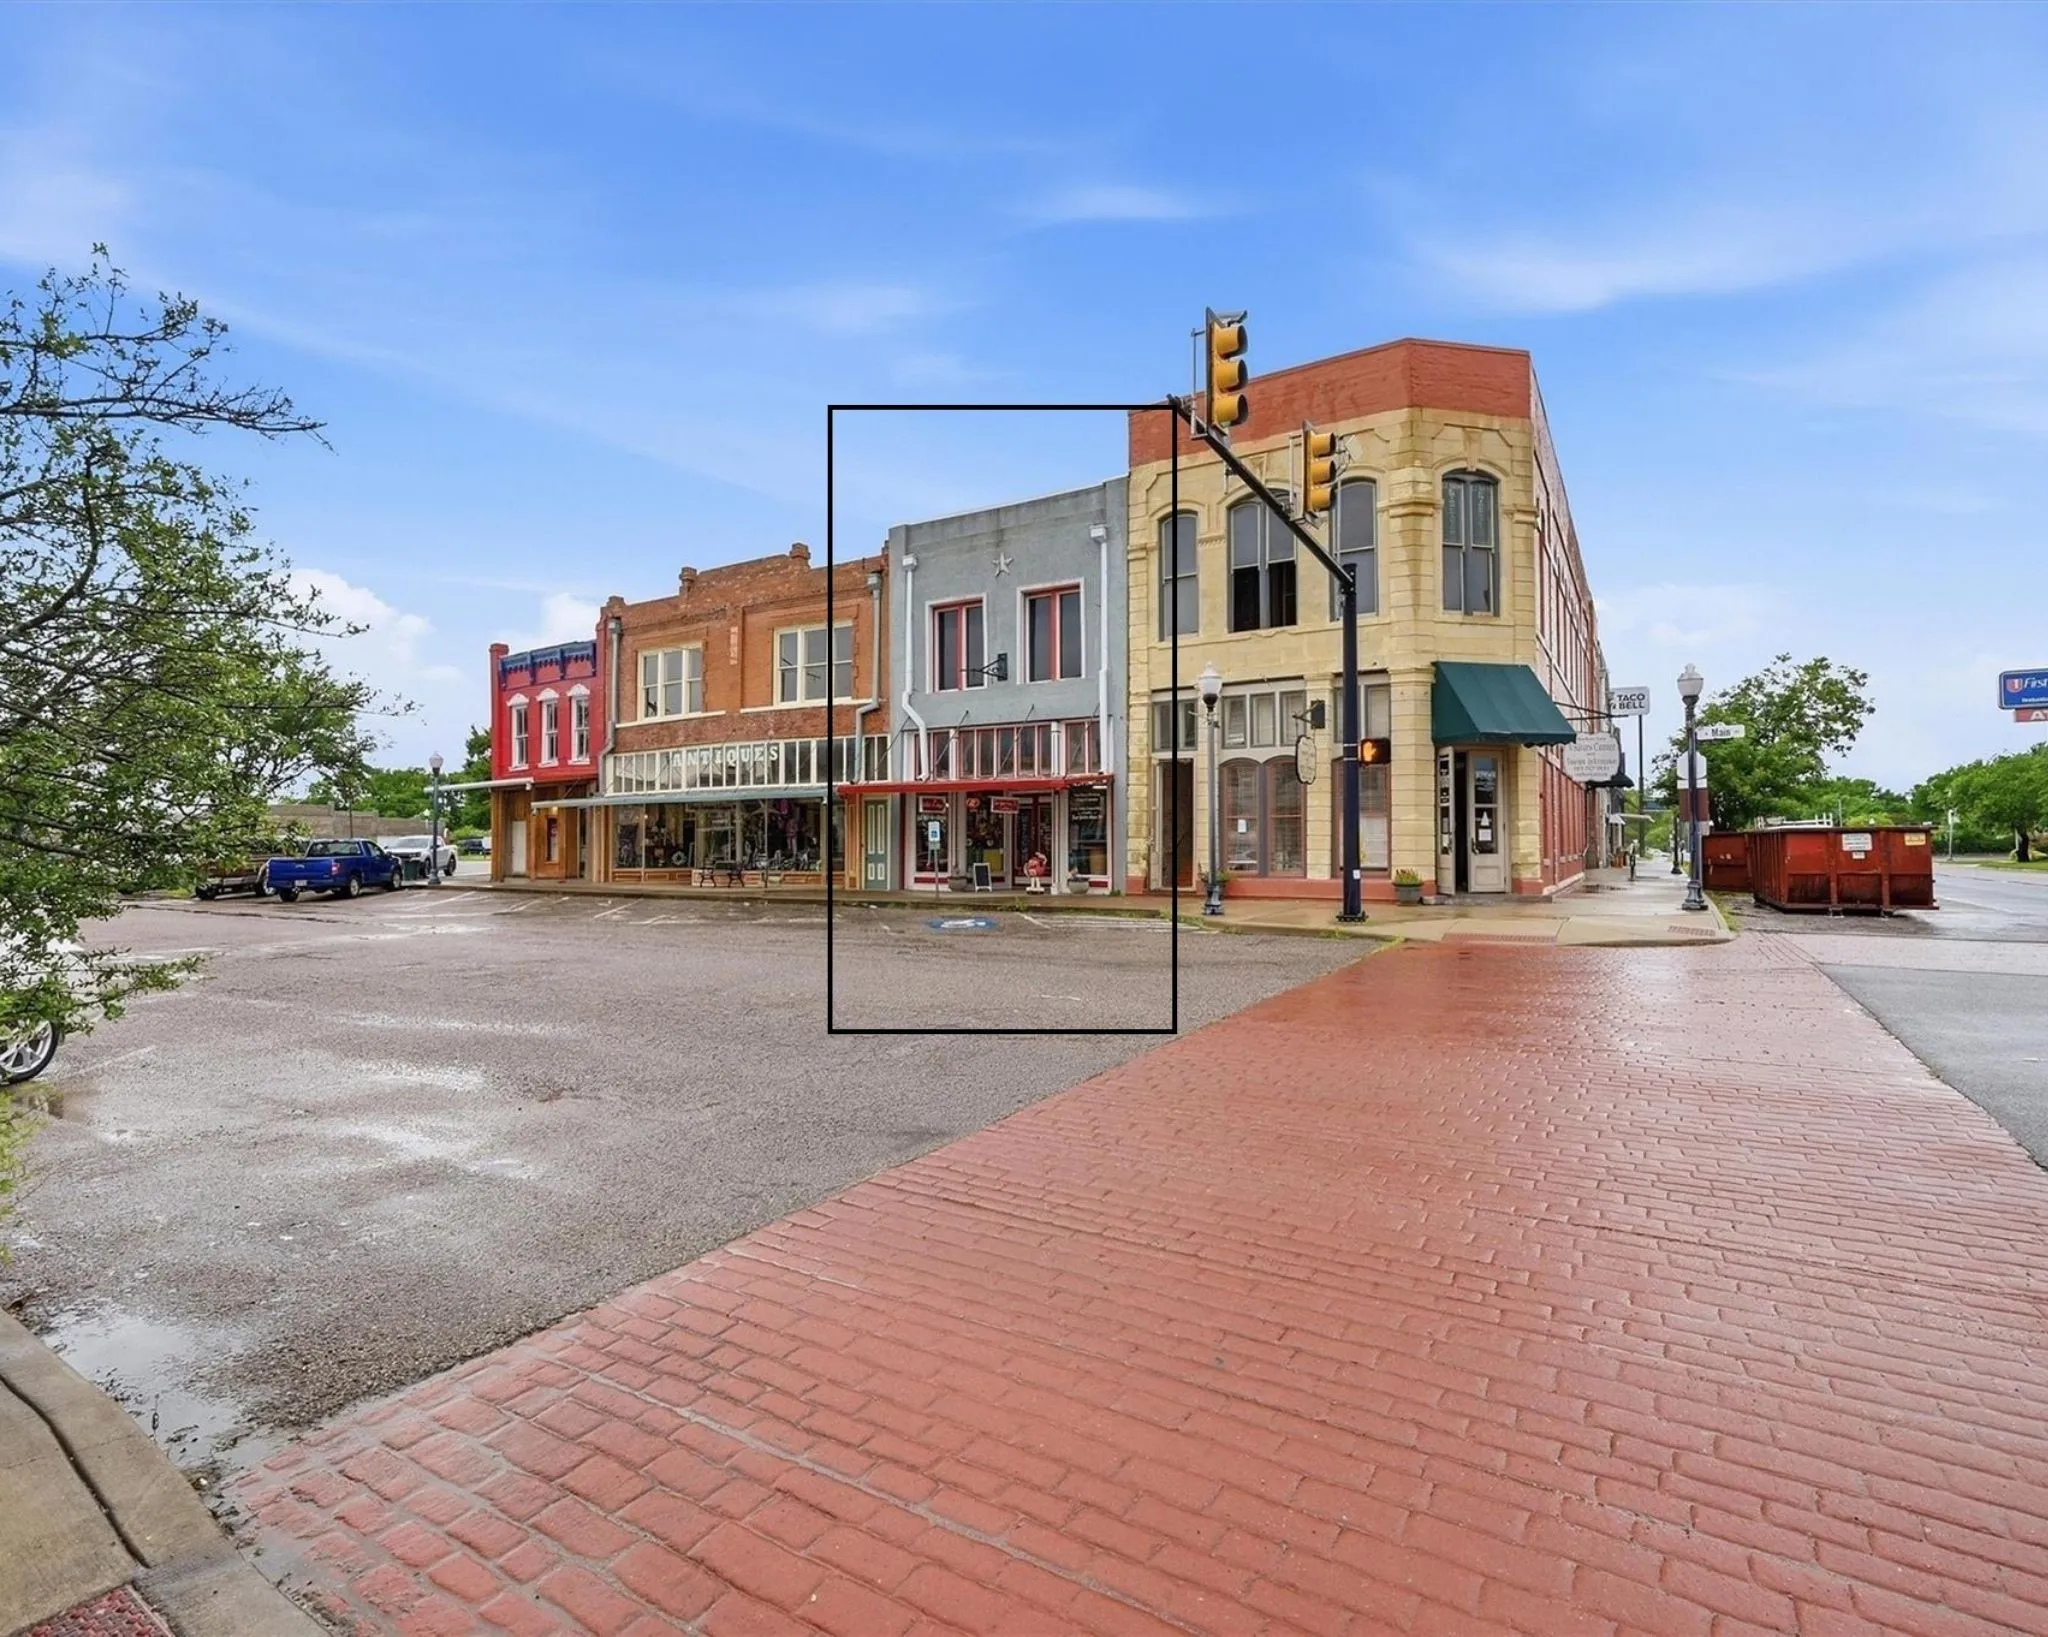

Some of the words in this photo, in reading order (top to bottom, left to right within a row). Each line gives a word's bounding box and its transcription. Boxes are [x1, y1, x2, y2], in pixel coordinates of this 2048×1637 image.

[1616, 693, 1646, 701] TACO
[1618, 701, 1645, 710] BELL
[1711, 728, 1731, 737] Main
[673, 746, 778, 767] ANTIQUES
